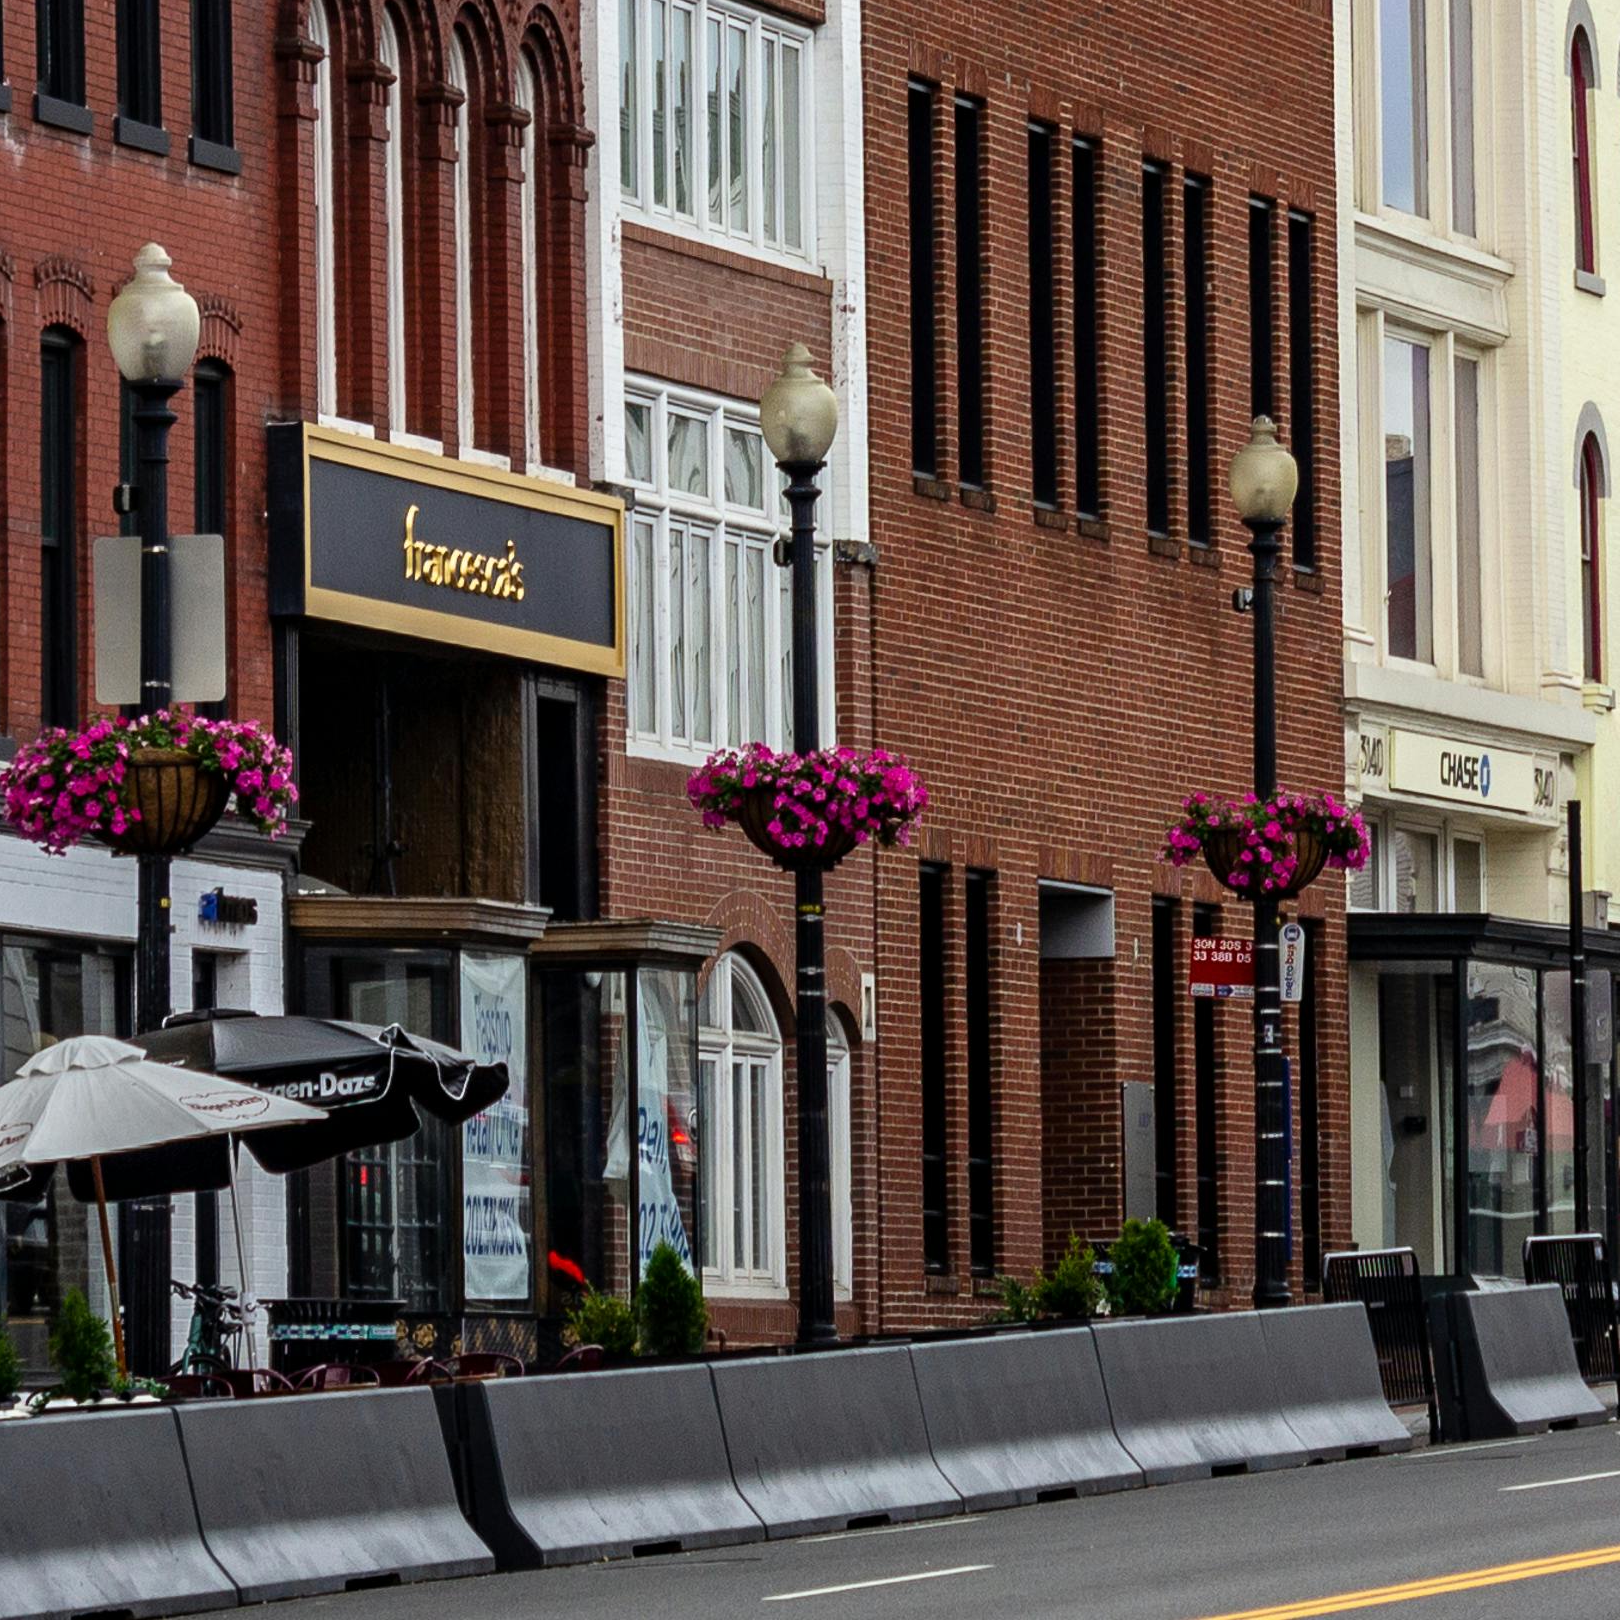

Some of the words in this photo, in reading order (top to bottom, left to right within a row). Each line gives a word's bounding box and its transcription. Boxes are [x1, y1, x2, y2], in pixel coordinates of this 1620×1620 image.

[1360, 734, 1384, 777] 3140
[1440, 751, 1479, 791] CHASE
[1193, 952, 1207, 961] 33
[1194, 939, 1216, 949] 30N
[1219, 940, 1241, 950] 30S
[1245, 940, 1253, 951] 3
